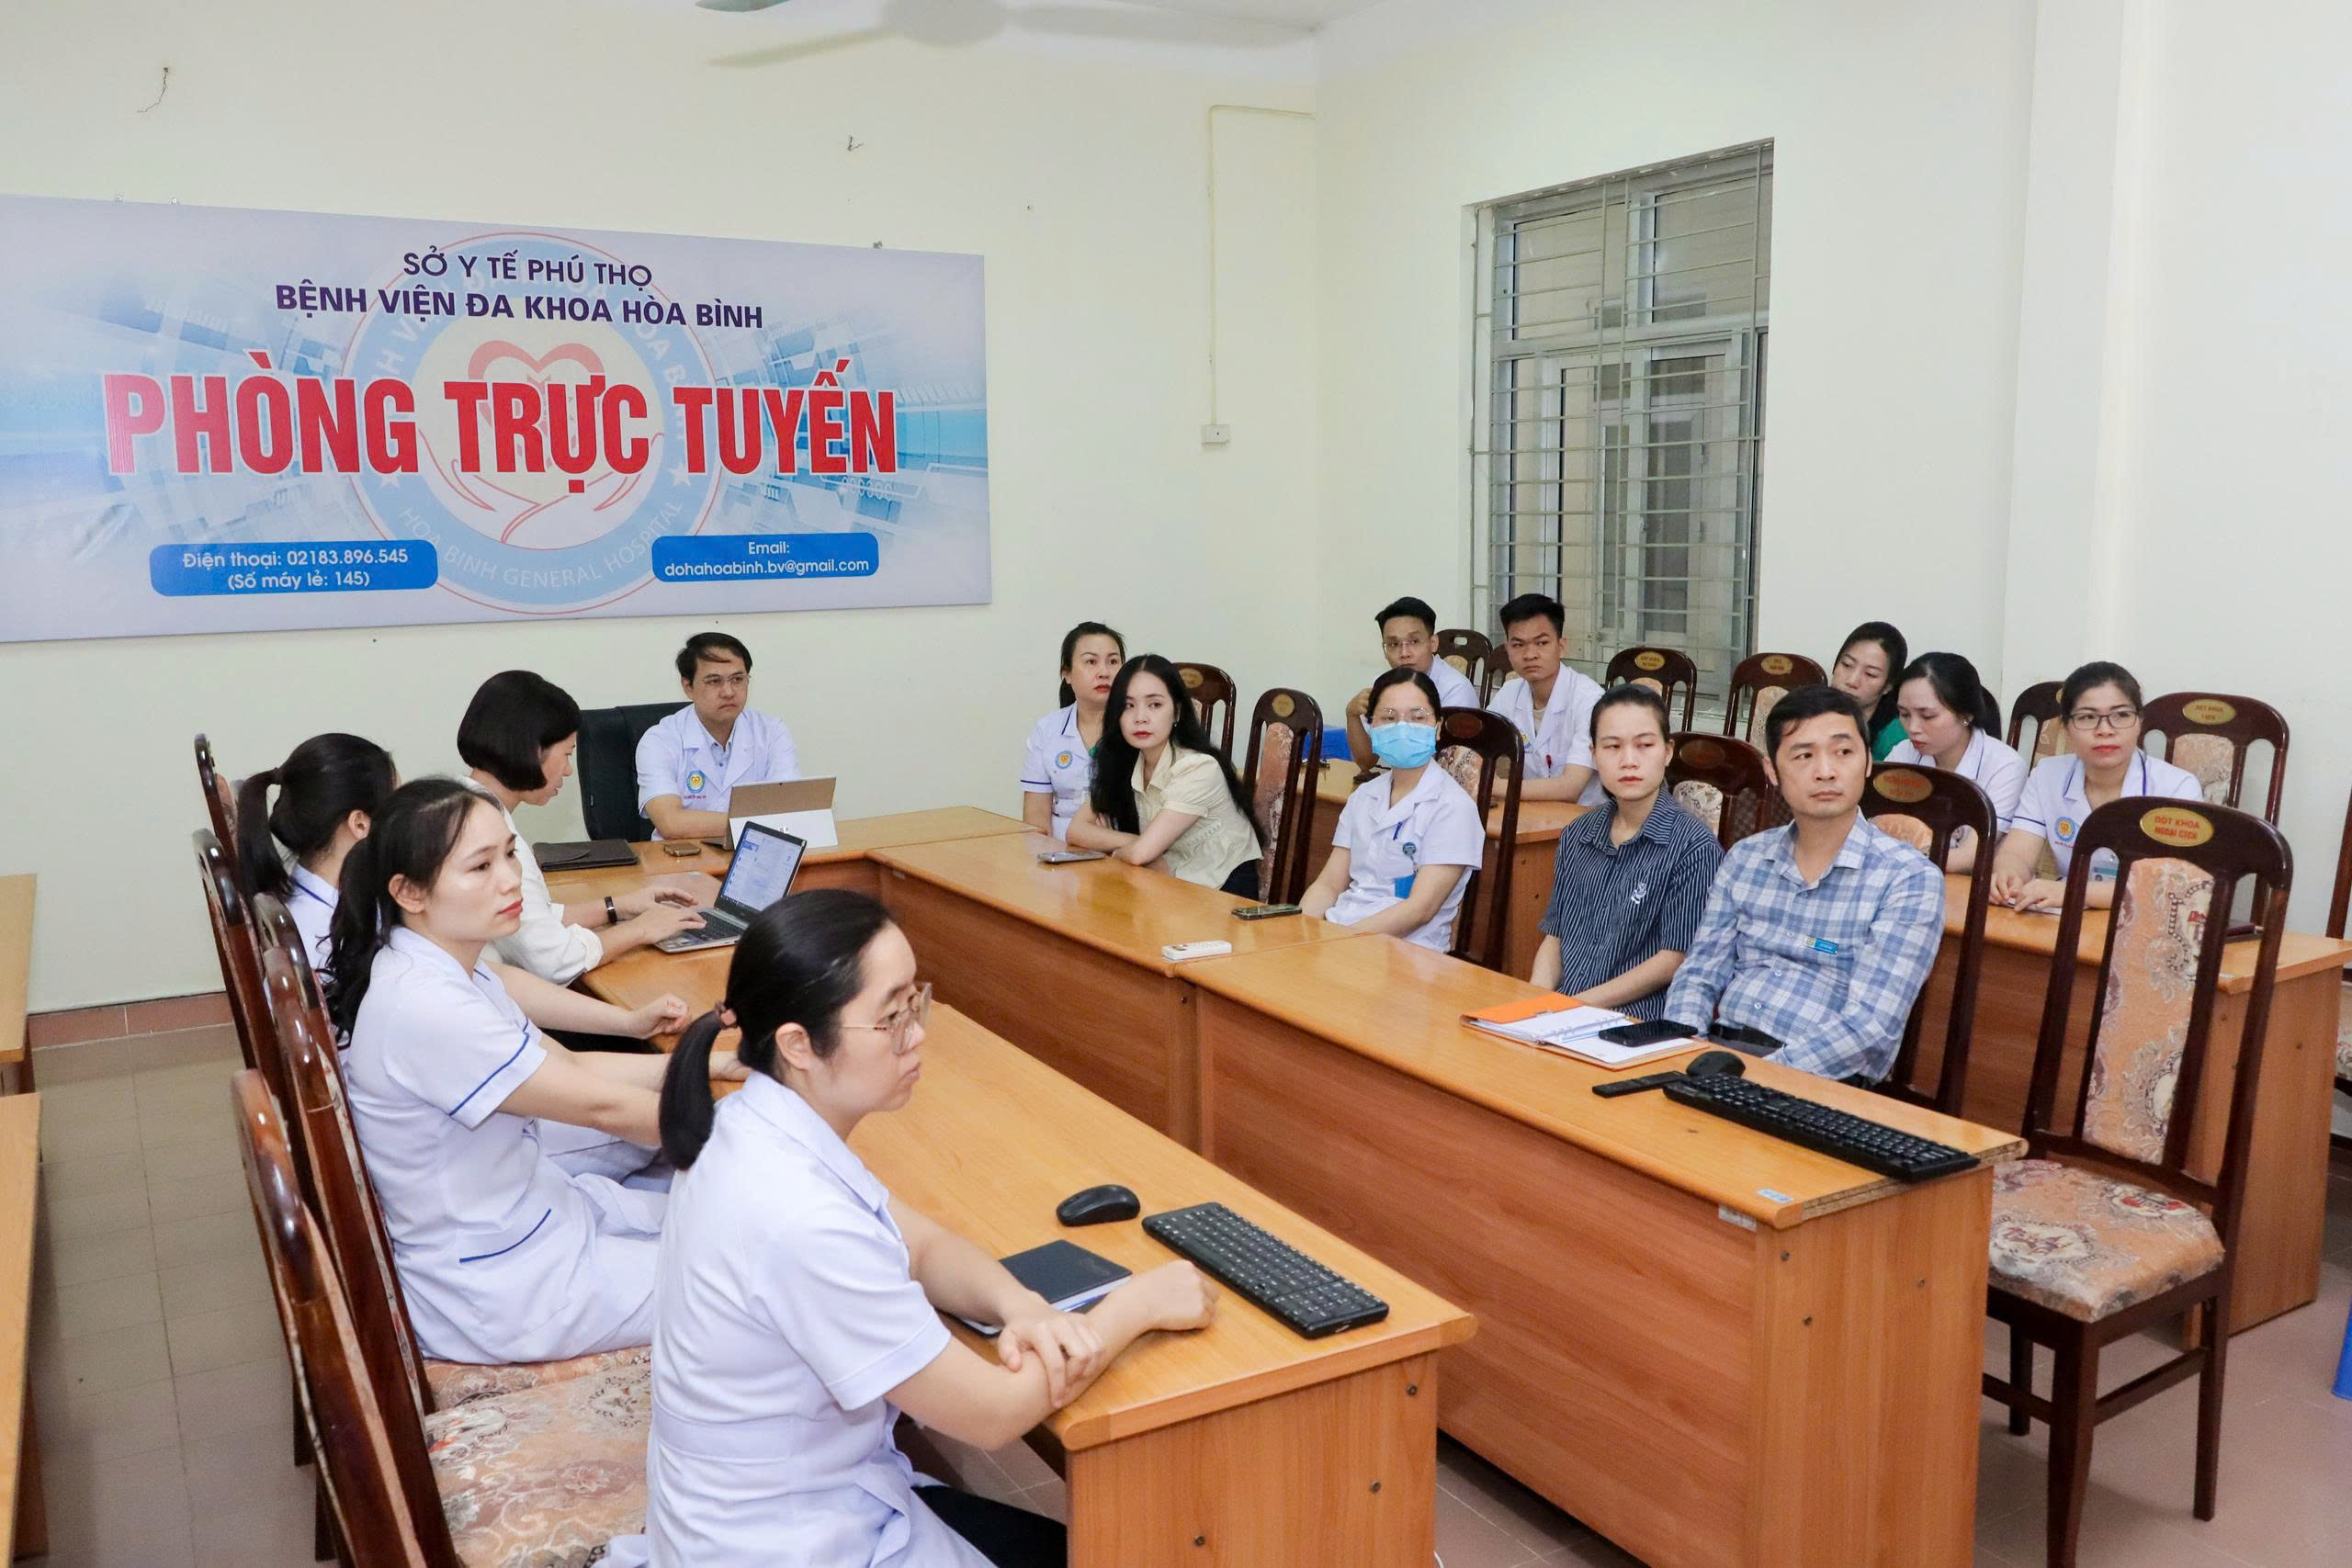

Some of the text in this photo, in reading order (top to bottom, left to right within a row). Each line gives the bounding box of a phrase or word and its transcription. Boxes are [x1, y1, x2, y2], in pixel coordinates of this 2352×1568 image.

[403, 244, 447, 276] SỞ
[458, 255, 478, 277] Y
[486, 249, 518, 280] TẾ
[527, 254, 584, 284] PHÚ
[594, 263, 652, 291] THỌ
[276, 279, 763, 329] BỆNH VIỆN ĐA KHOA HÒA BÌNH
[105, 351, 420, 474] PHÒNG
[443, 374, 651, 494] TRỰC
[673, 358, 898, 475] TUYẾN
[182, 548, 408, 570] Điện thoại: 02183.896.545
[503, 564, 603, 588] GENERAL
[604, 502, 684, 571] HOSPITAL
[748, 541, 790, 555] Email:
[228, 570, 370, 591] (Số máy lẻ: 145)
[664, 558, 870, 577] dohahoabinh.bv@gmail.com
